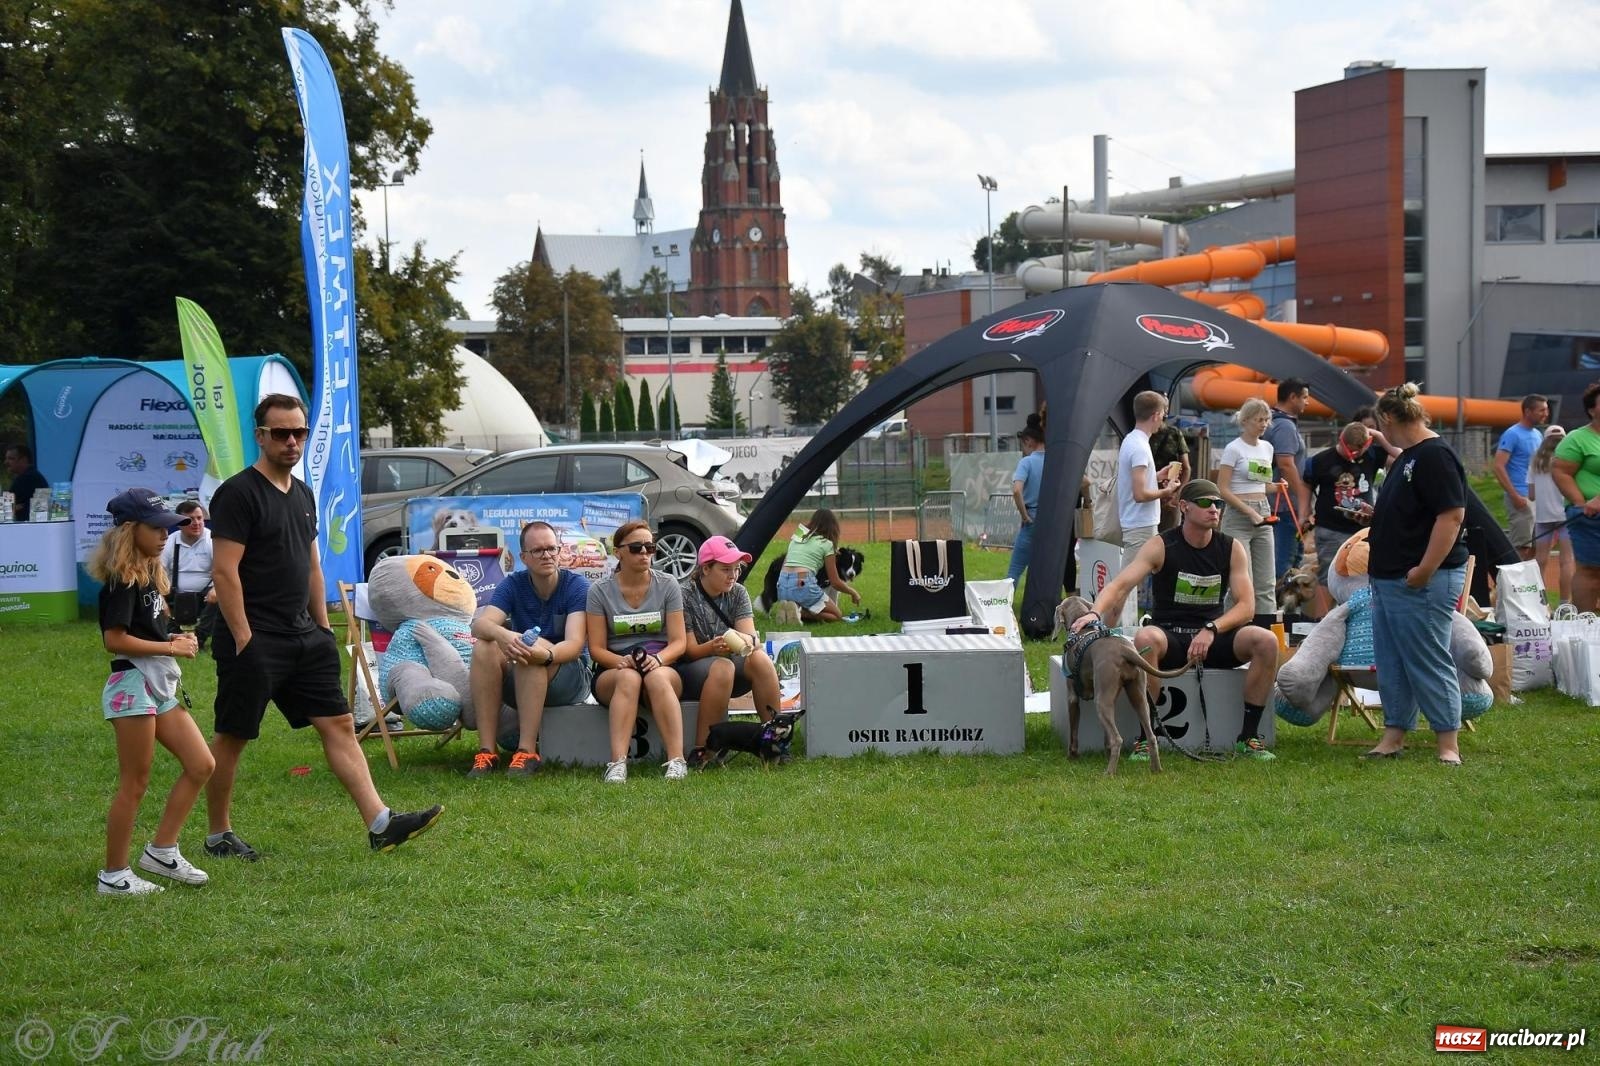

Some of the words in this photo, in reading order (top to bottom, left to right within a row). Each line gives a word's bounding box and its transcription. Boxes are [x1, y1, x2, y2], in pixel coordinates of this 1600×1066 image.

[483, 508, 534, 519] REGULARNIE
[537, 508, 569, 518] KROPLE
[629, 623, 647, 633] 13
[1515, 629, 1547, 638] ADULT
[903, 662, 928, 714] 1
[1154, 685, 1190, 740] 2
[627, 716, 650, 759] 3
[848, 729, 890, 743] OSIR
[895, 725, 984, 743] RACIBÓRZ
